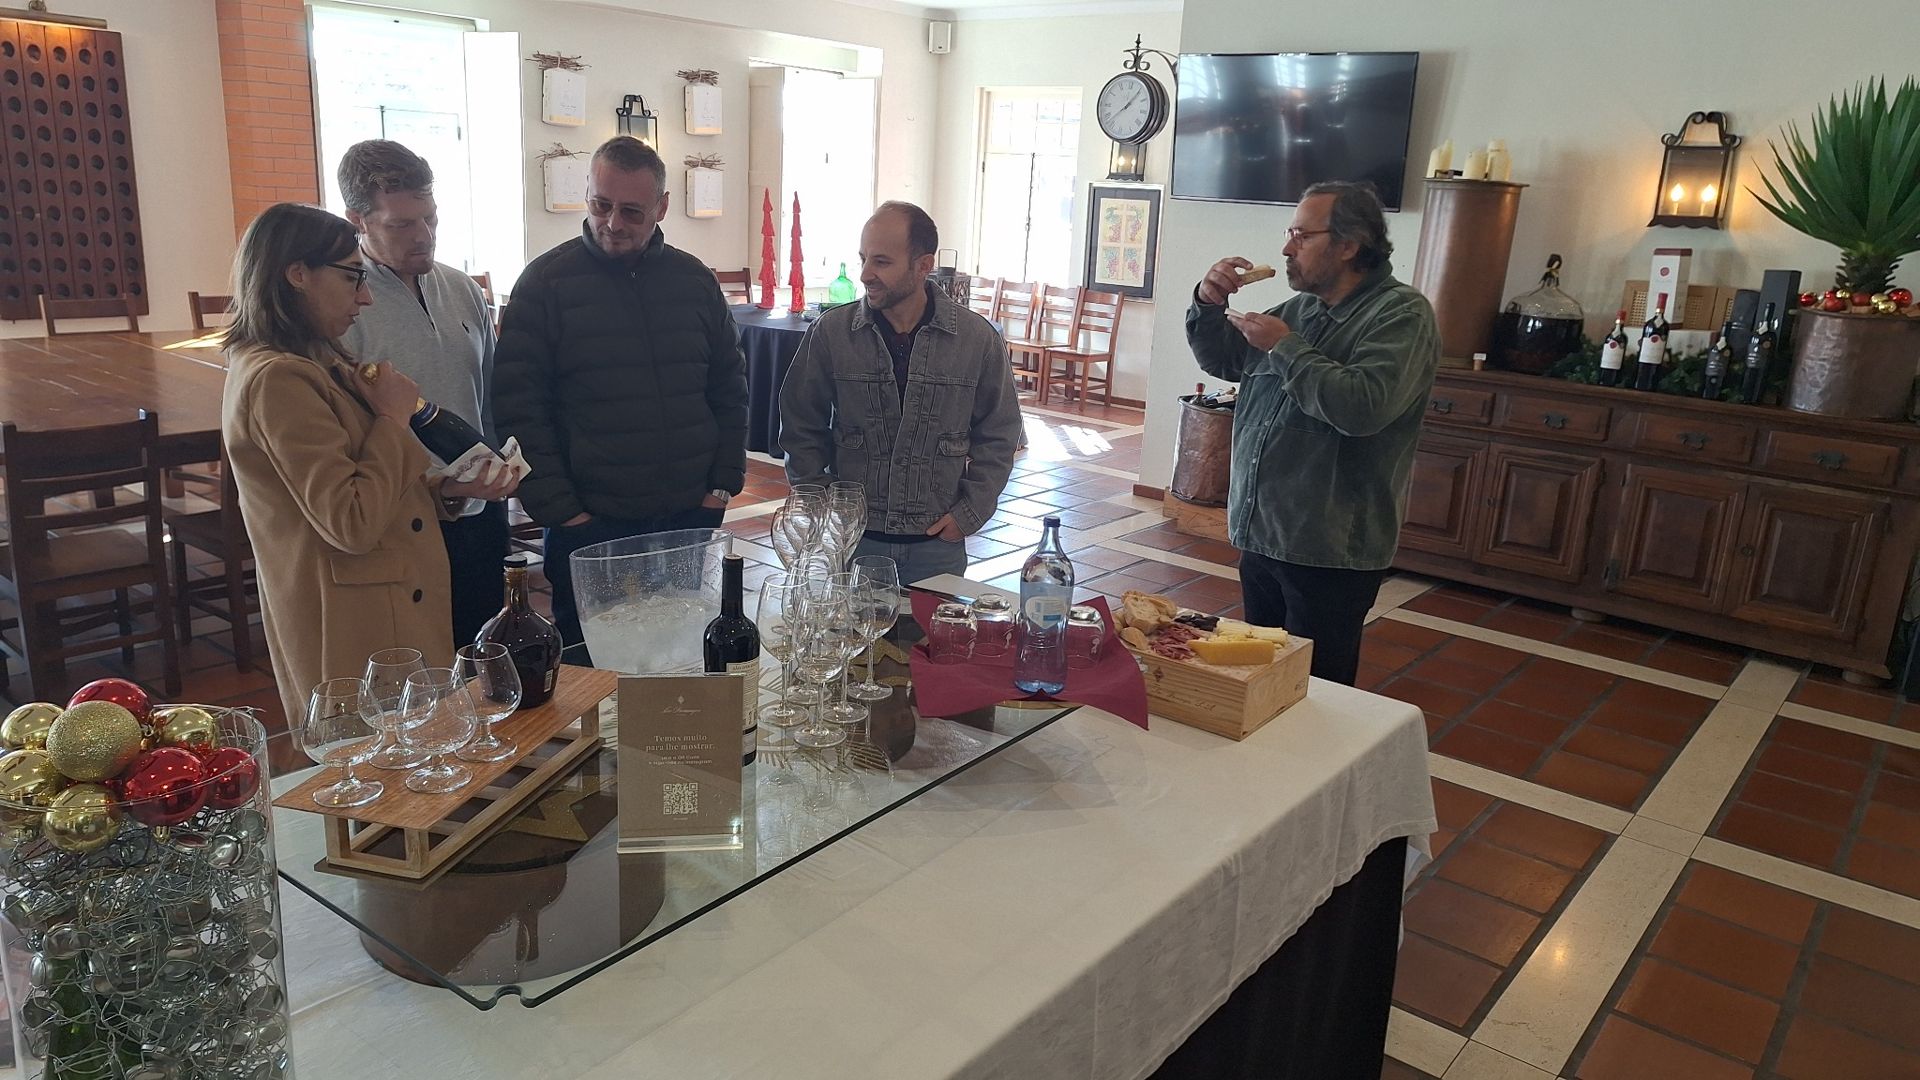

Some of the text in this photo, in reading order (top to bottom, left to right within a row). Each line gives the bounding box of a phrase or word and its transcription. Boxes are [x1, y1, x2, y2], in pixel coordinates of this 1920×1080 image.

[683, 734, 707, 742] muito
[645, 744, 664, 753] para
[665, 743, 679, 751] lhe
